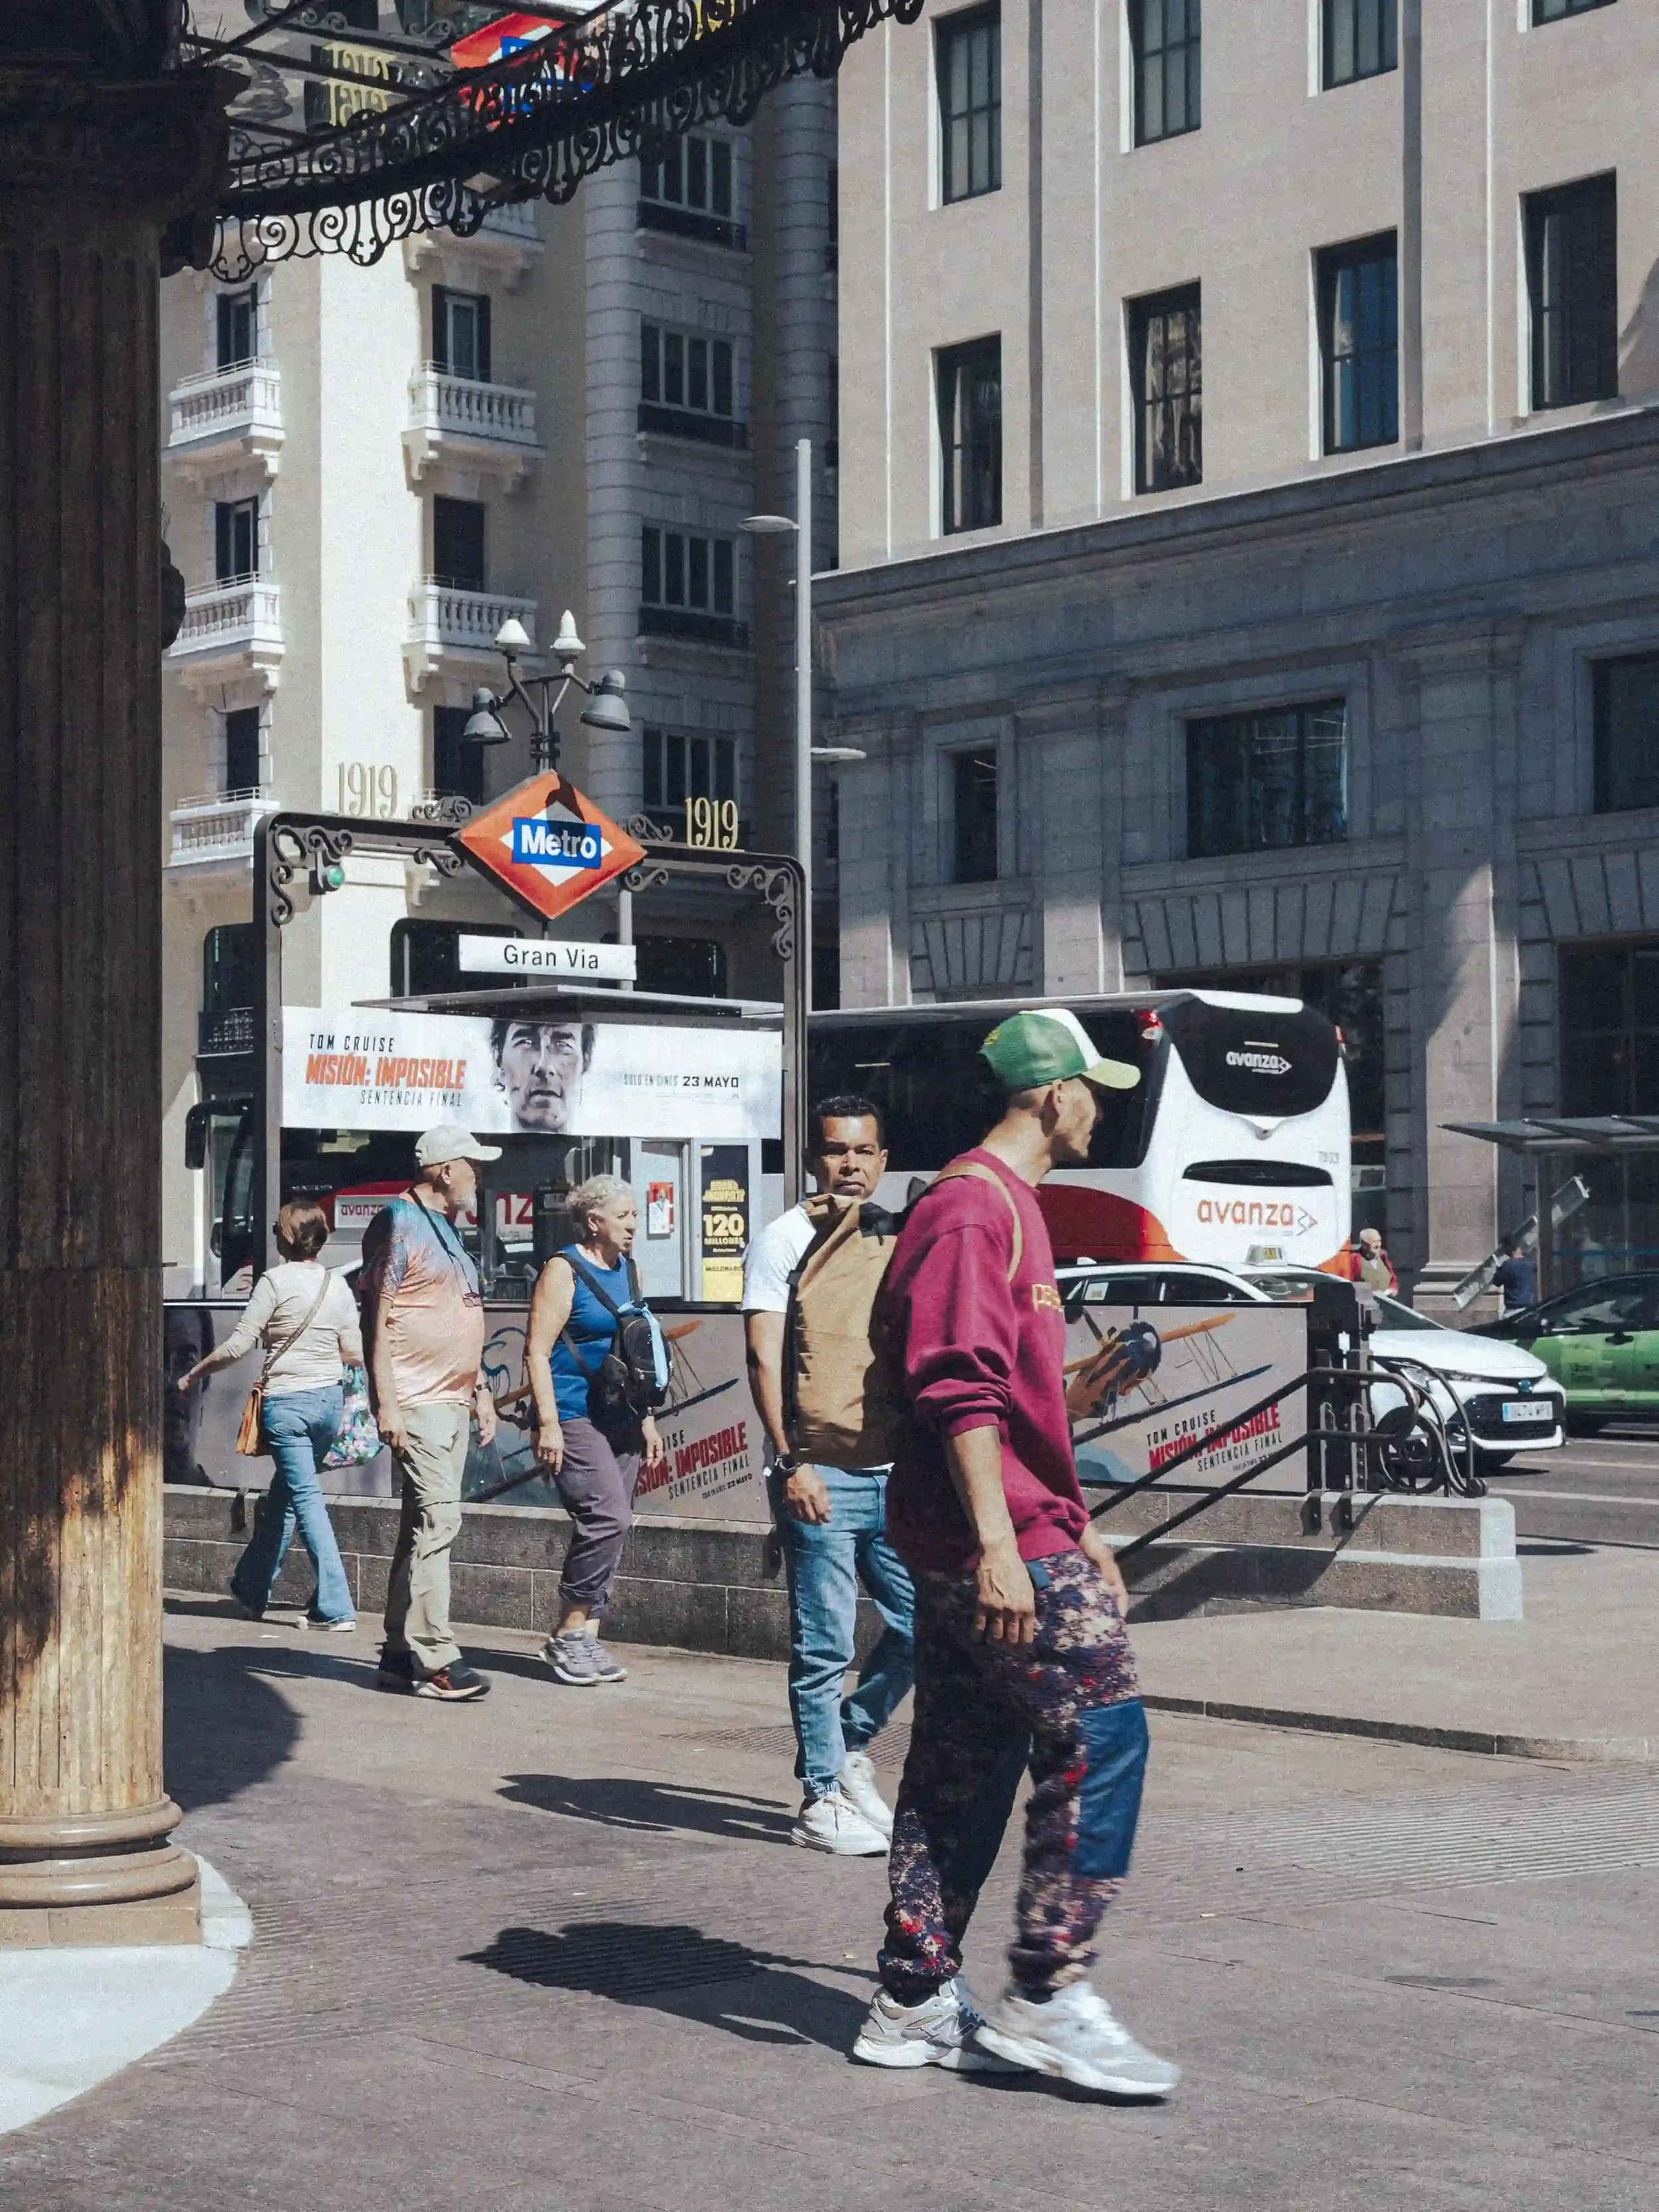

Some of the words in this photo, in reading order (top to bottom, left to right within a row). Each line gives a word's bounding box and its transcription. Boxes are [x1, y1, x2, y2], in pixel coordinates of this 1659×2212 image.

[338, 762, 398, 818] 1919
[685, 796, 739, 850] 1919
[521, 824, 597, 859] Metro
[504, 944, 557, 966] Gran
[566, 948, 599, 970] Via
[309, 1034, 334, 1050] TOM
[344, 1036, 395, 1052] CRUISE
[1226, 1051, 1279, 1069] avanza
[305, 1052, 372, 1086] MISIÓN:
[376, 1056, 467, 1090] IMPOSIBLE
[683, 1076, 699, 1086] 23
[704, 1076, 739, 1088] MAYO
[360, 1090, 422, 1105] SENTENCIA
[430, 1092, 463, 1107] FINAL
[702, 1213, 745, 1237] 120
[1197, 1199, 1294, 1226] avanza
[1147, 1428, 1168, 1447] TOM
[1175, 1409, 1216, 1436] CRUISE
[674, 1421, 749, 1479] IMPOSIBLE
[1198, 1443, 1250, 1472] SENTENCIA
[1255, 1430, 1283, 1451] FINAL
[668, 1467, 719, 1500] SENTENCIA
[723, 1453, 750, 1477] FINAL
